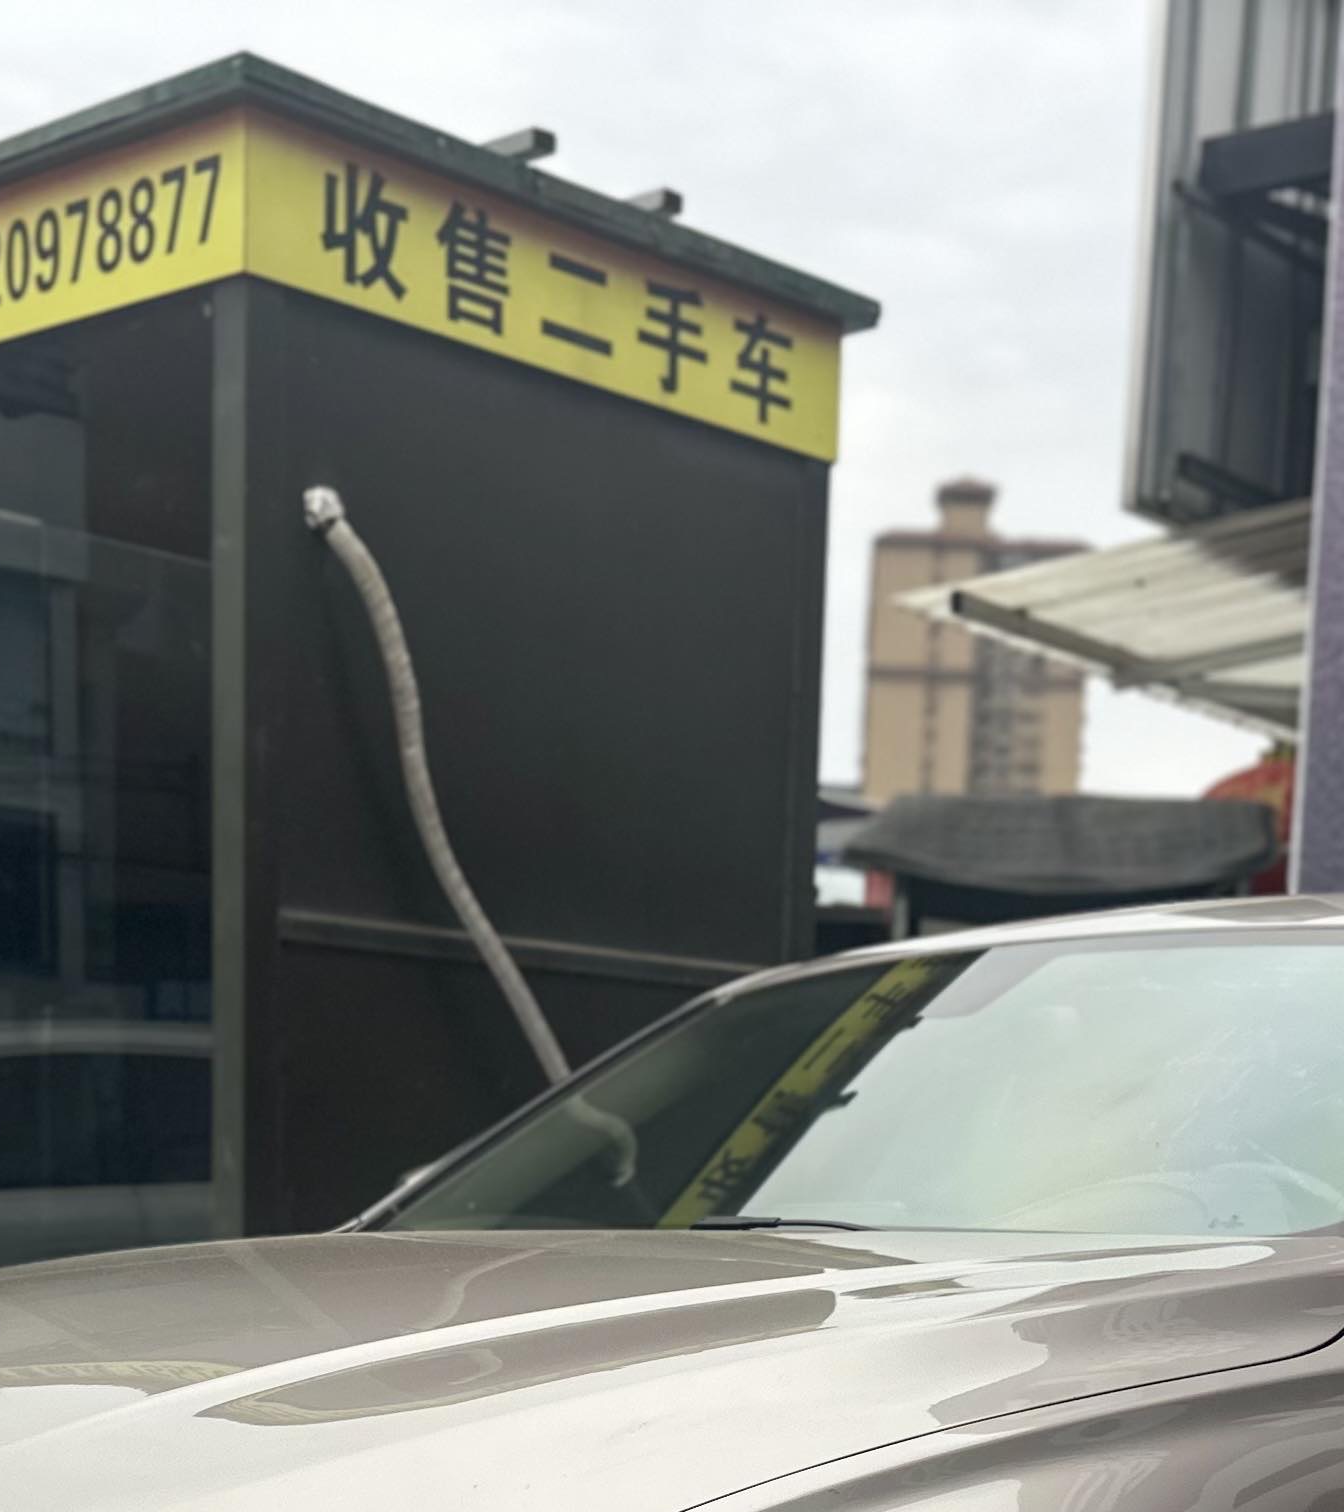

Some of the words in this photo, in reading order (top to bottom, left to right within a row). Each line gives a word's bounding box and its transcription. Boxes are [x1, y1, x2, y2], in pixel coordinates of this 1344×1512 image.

[320, 160, 794, 425] 收售二手车
